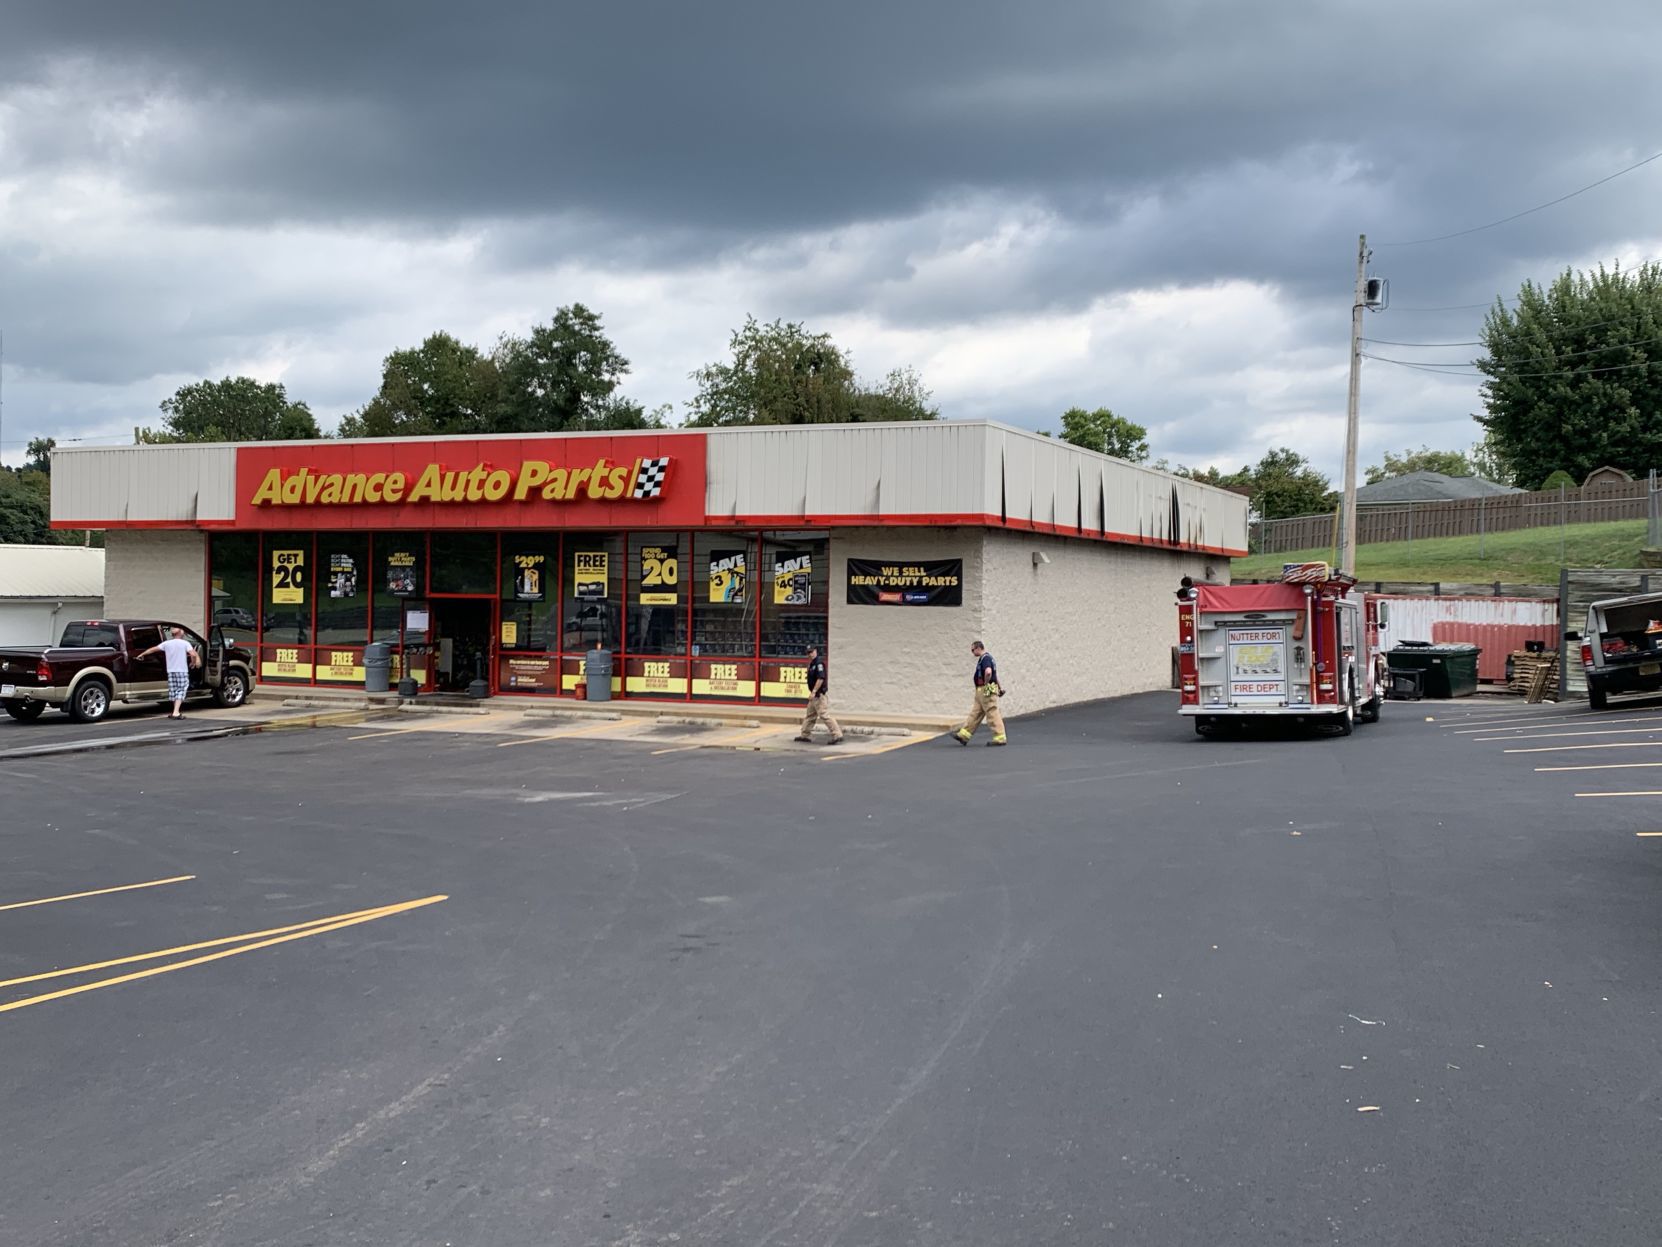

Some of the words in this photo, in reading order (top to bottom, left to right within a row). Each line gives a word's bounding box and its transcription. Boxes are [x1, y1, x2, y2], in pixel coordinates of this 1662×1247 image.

[251, 468, 404, 506] Advance
[408, 463, 511, 503] Auto
[513, 457, 627, 501] Parts
[278, 553, 299, 564] GET
[577, 554, 606, 567] FREE
[710, 554, 745, 574] SAVE
[775, 555, 811, 576] SAVE
[881, 567, 899, 576] WE
[902, 567, 926, 576] SELL
[851, 576, 919, 586] HEAVY-DUTY
[922, 576, 958, 586] PARTS
[1230, 632, 1259, 641] NUTTER
[276, 649, 298, 662] FREE
[331, 652, 354, 666] FREE
[644, 662, 670, 677] FREE
[710, 664, 737, 679] FREE
[779, 667, 808, 683] FREE
[1234, 684, 1254, 692] FIRE
[1257, 684, 1282, 692] DEPT.
